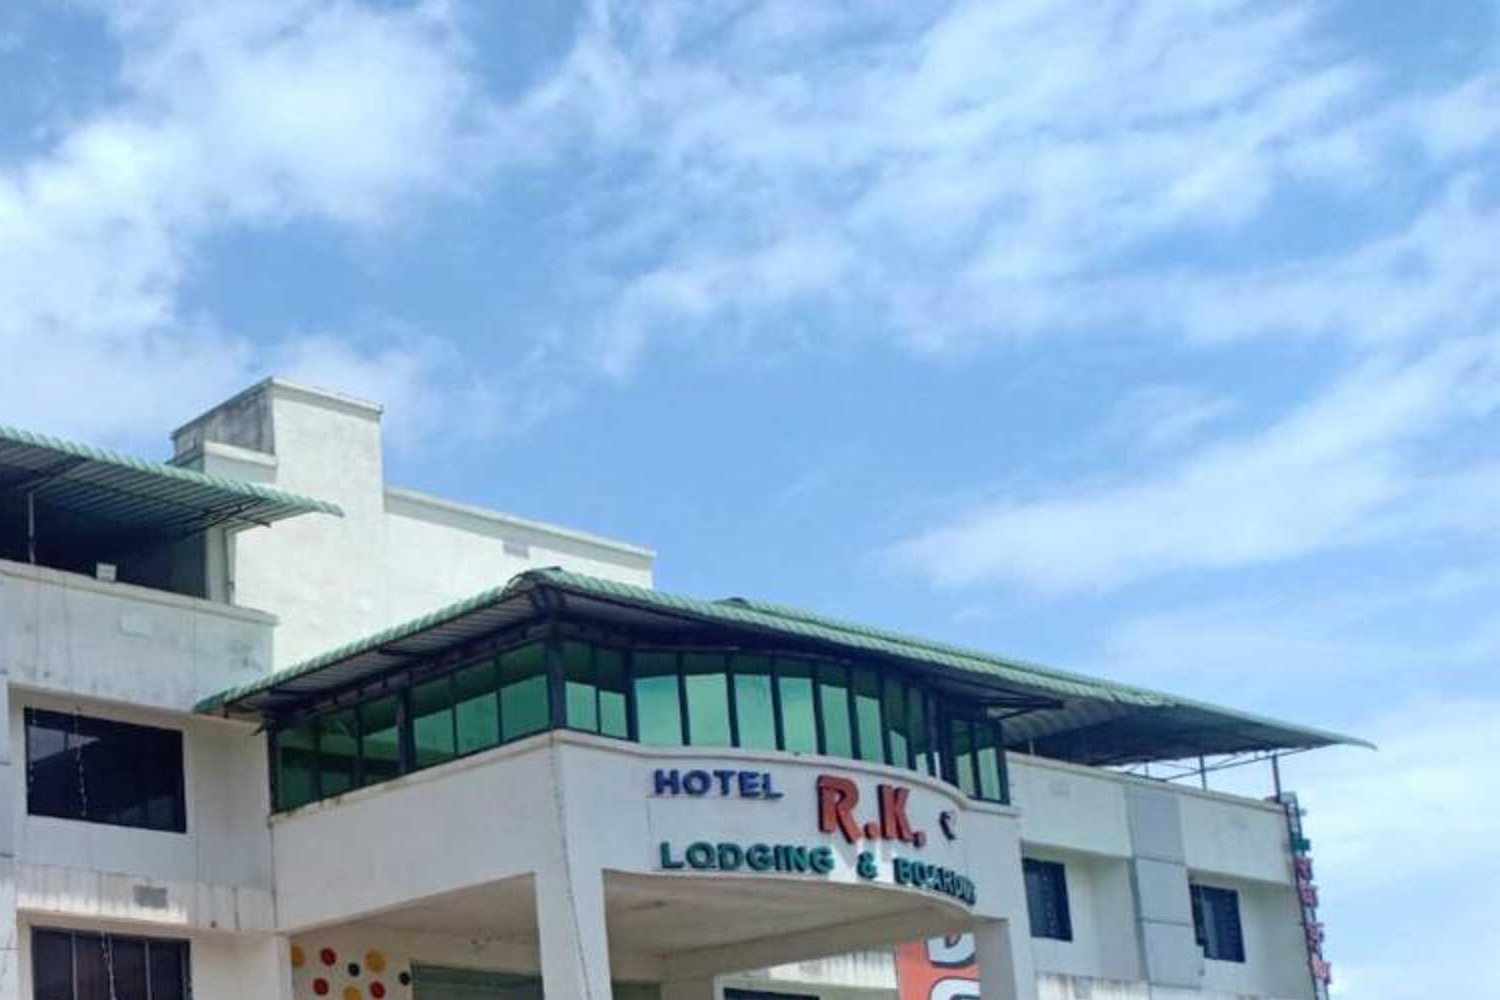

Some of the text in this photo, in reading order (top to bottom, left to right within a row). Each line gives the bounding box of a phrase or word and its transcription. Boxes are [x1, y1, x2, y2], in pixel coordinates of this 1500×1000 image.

[654, 769, 784, 800] HOTEL
[816, 774, 927, 849] R.K.
[659, 841, 835, 875] LODGING
[856, 851, 879, 879] &
